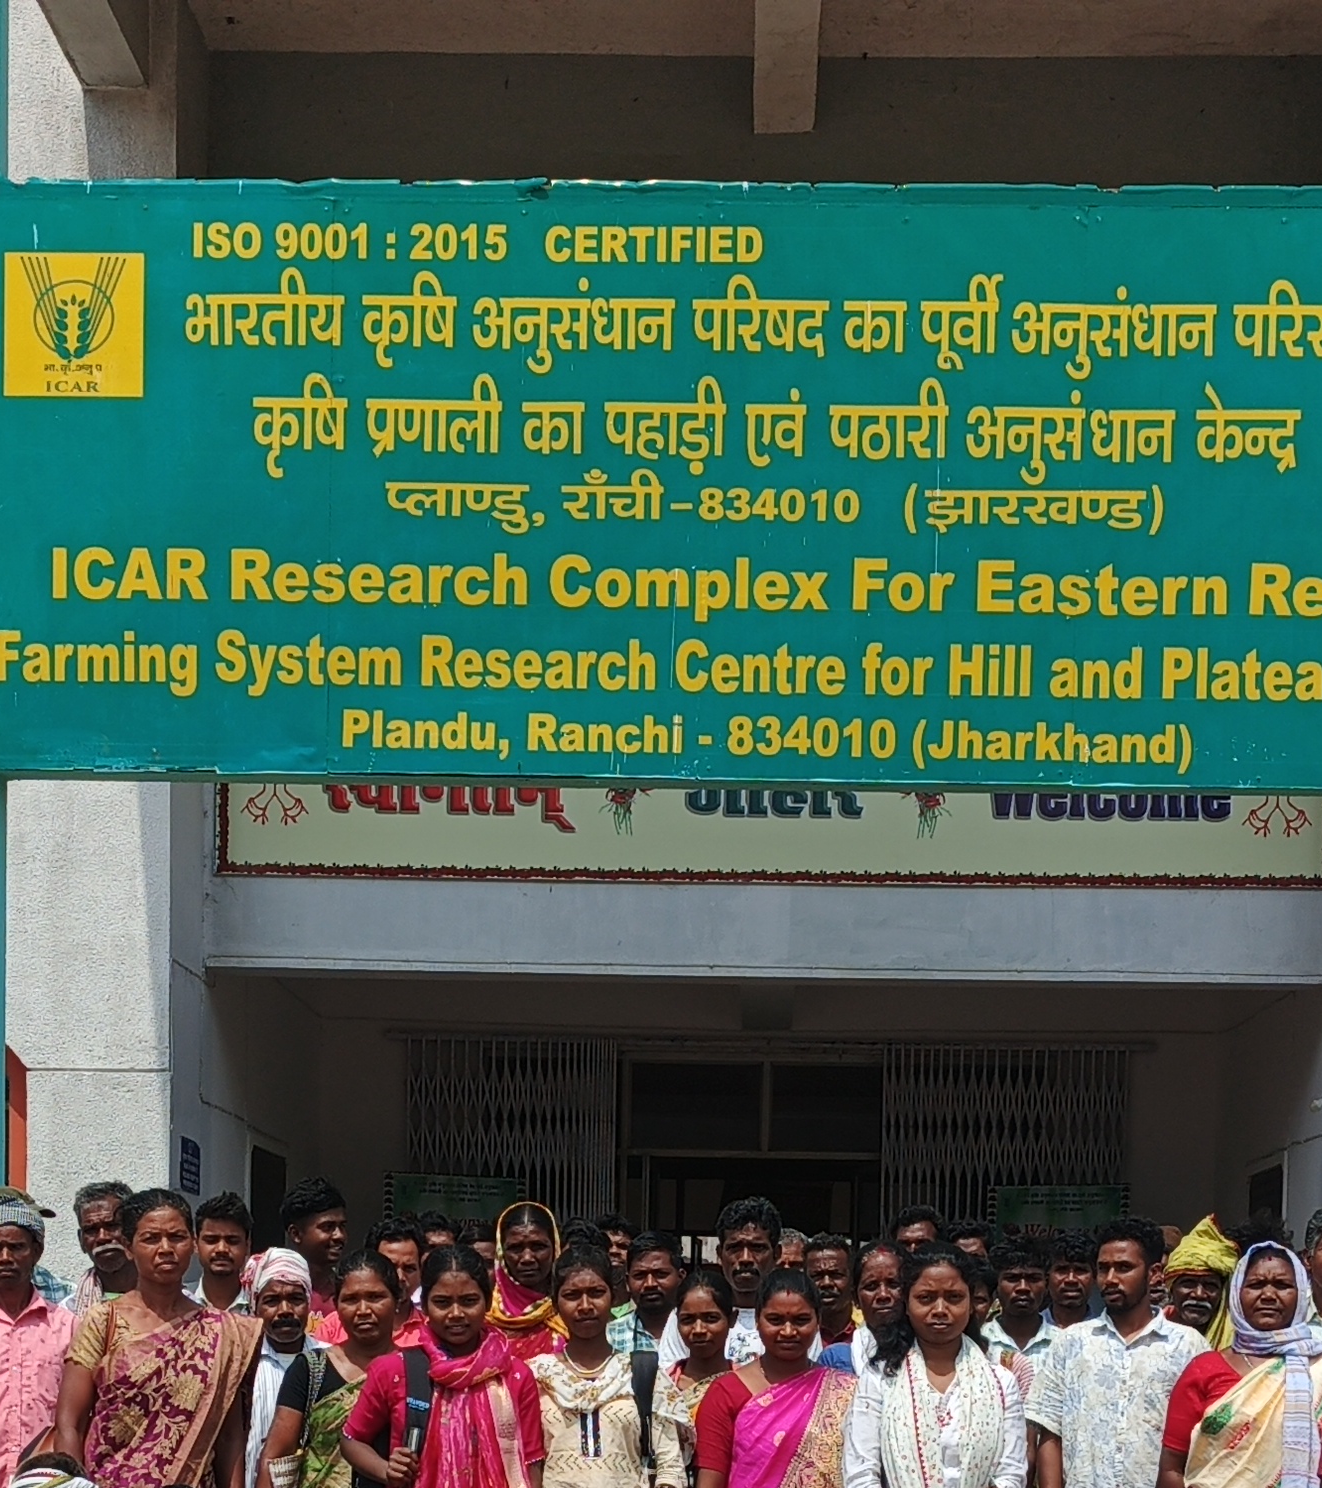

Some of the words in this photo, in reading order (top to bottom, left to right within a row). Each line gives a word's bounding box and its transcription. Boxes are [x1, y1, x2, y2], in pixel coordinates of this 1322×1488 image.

[193, 223, 262, 259] ISO
[275, 223, 369, 260] 9001
[386, 224, 396, 259] :
[410, 224, 507, 261] 2015
[545, 225, 763, 263] CERTIFIED
[185, 267, 345, 346] भारतीय
[362, 271, 458, 368] कृषि
[473, 279, 676, 374] अनुसंधान
[693, 275, 830, 357] परिषद
[844, 301, 908, 353] का
[921, 274, 1004, 370] पूर्वी
[1012, 288, 1218, 380] अनुसंधान
[46, 380, 101, 393] ICAR
[253, 373, 348, 478] कृषि
[366, 374, 503, 458] प्रणाली
[522, 402, 585, 454] का
[605, 376, 727, 476] पहाड़ी
[745, 391, 807, 467] एवं
[829, 379, 950, 460] पठारी
[966, 389, 1176, 486] अनुसंधान
[1195, 382, 1302, 473] केन्द्र
[51, 546, 209, 601] ICAR
[230, 548, 529, 607] Research
[549, 554, 829, 623] Complex
[852, 557, 956, 613] For
[976, 559, 1229, 617] Eastern
[215, 629, 403, 698] System
[420, 635, 657, 691] Research
[674, 639, 847, 697] Centre
[861, 643, 934, 697] for
[948, 645, 1033, 698] Hill
[1049, 647, 1144, 701] and
[341, 708, 510, 760] Plandu,
[527, 712, 683, 755] Ranchi
[727, 715, 897, 760] 834010
[912, 720, 1193, 774] (Jharkhand)
